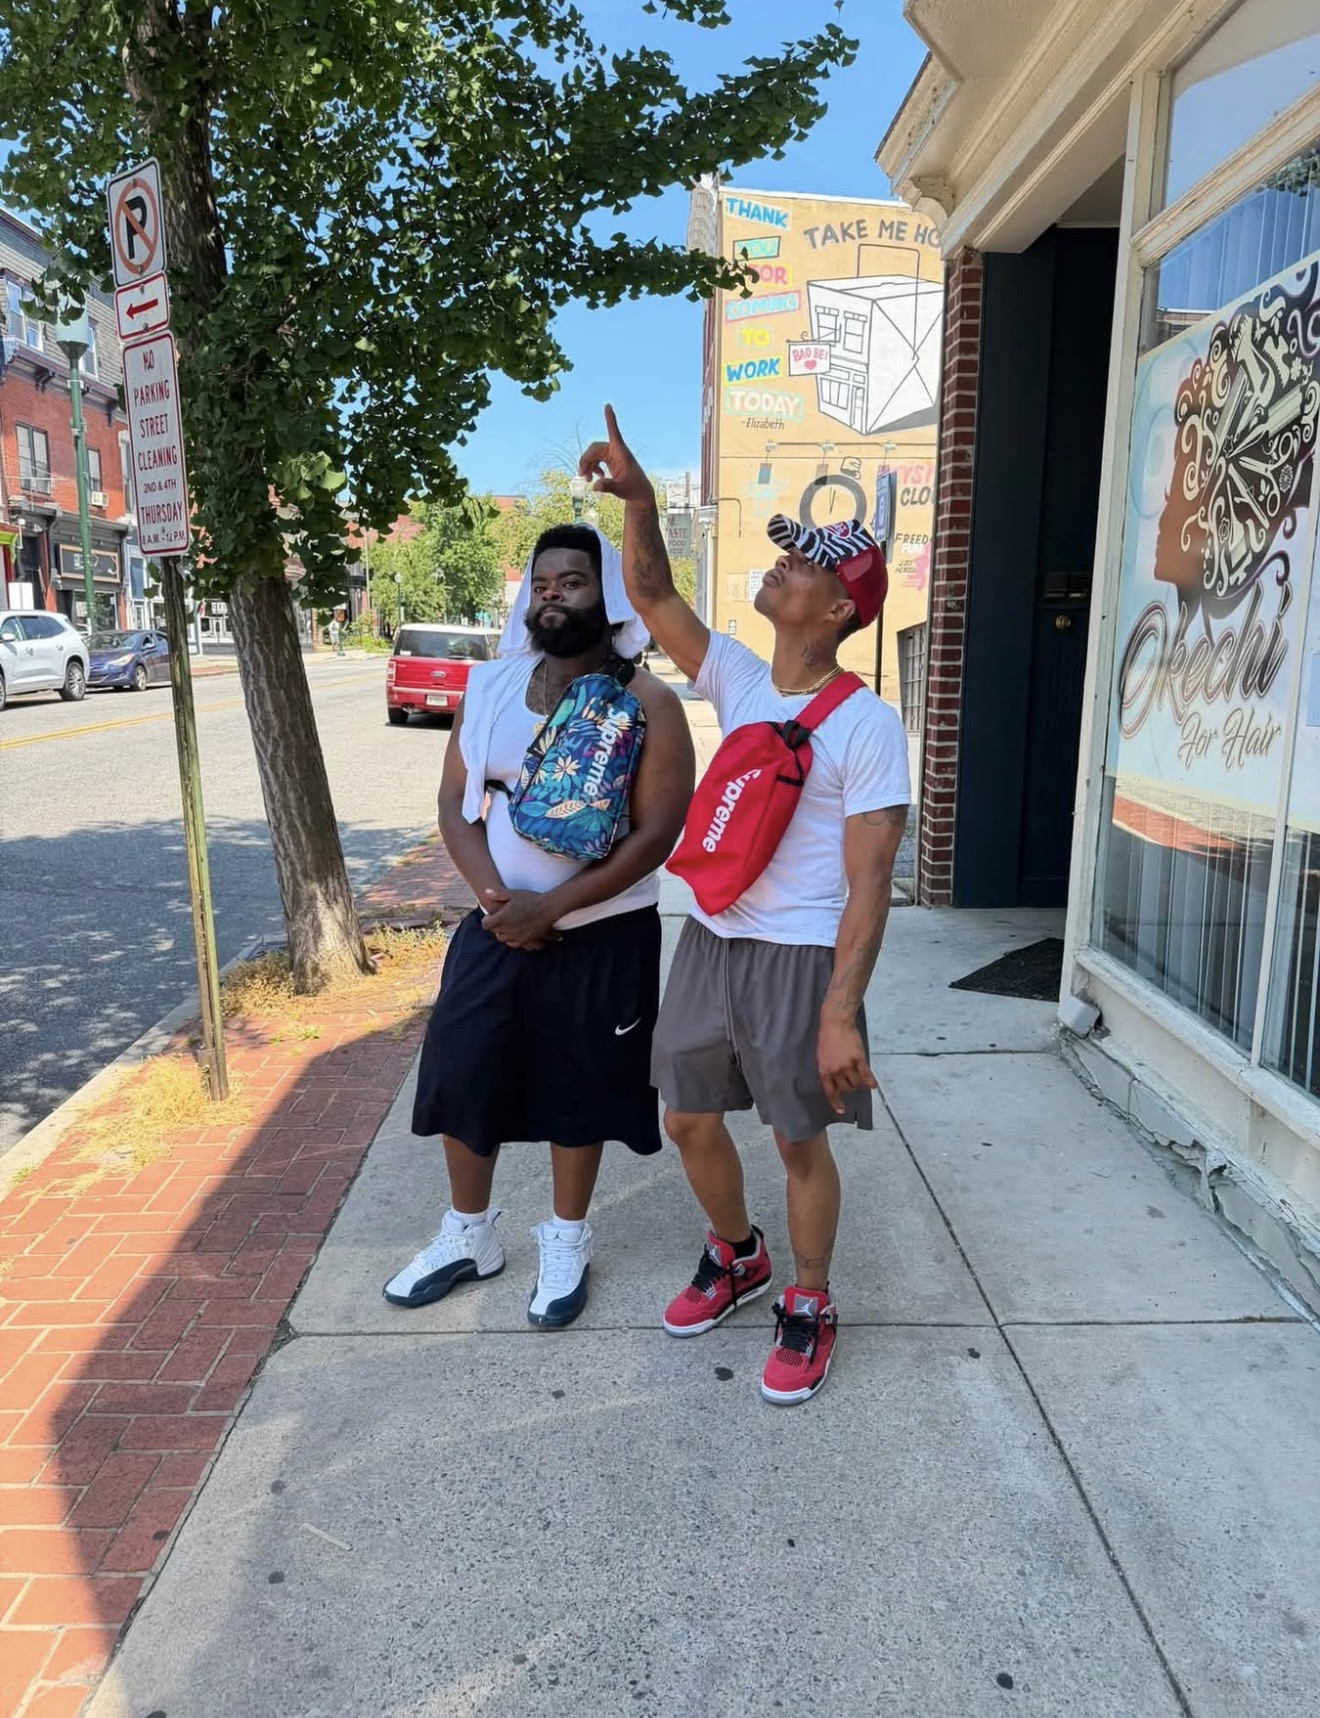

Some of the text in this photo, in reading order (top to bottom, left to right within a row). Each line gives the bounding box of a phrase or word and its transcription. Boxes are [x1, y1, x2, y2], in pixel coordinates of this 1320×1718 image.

[725, 197, 788, 228] THANK
[125, 195, 148, 260] P
[803, 219, 869, 249] TAKE
[878, 219, 908, 241] ME
[726, 294, 797, 320] COMING
[742, 327, 769, 347] TO
[143, 350, 154, 371] NO
[726, 358, 781, 382] WORK
[134, 379, 170, 408] PARKING
[730, 389, 800, 417] TODAY
[140, 413, 168, 439] STREET
[138, 445, 178, 471] CLEANING
[144, 478, 177, 494] 2ND & 4TH
[141, 501, 182, 525] THURSDAY
[1178, 706, 1281, 768] For Hair
[583, 707, 631, 796] Supreme
